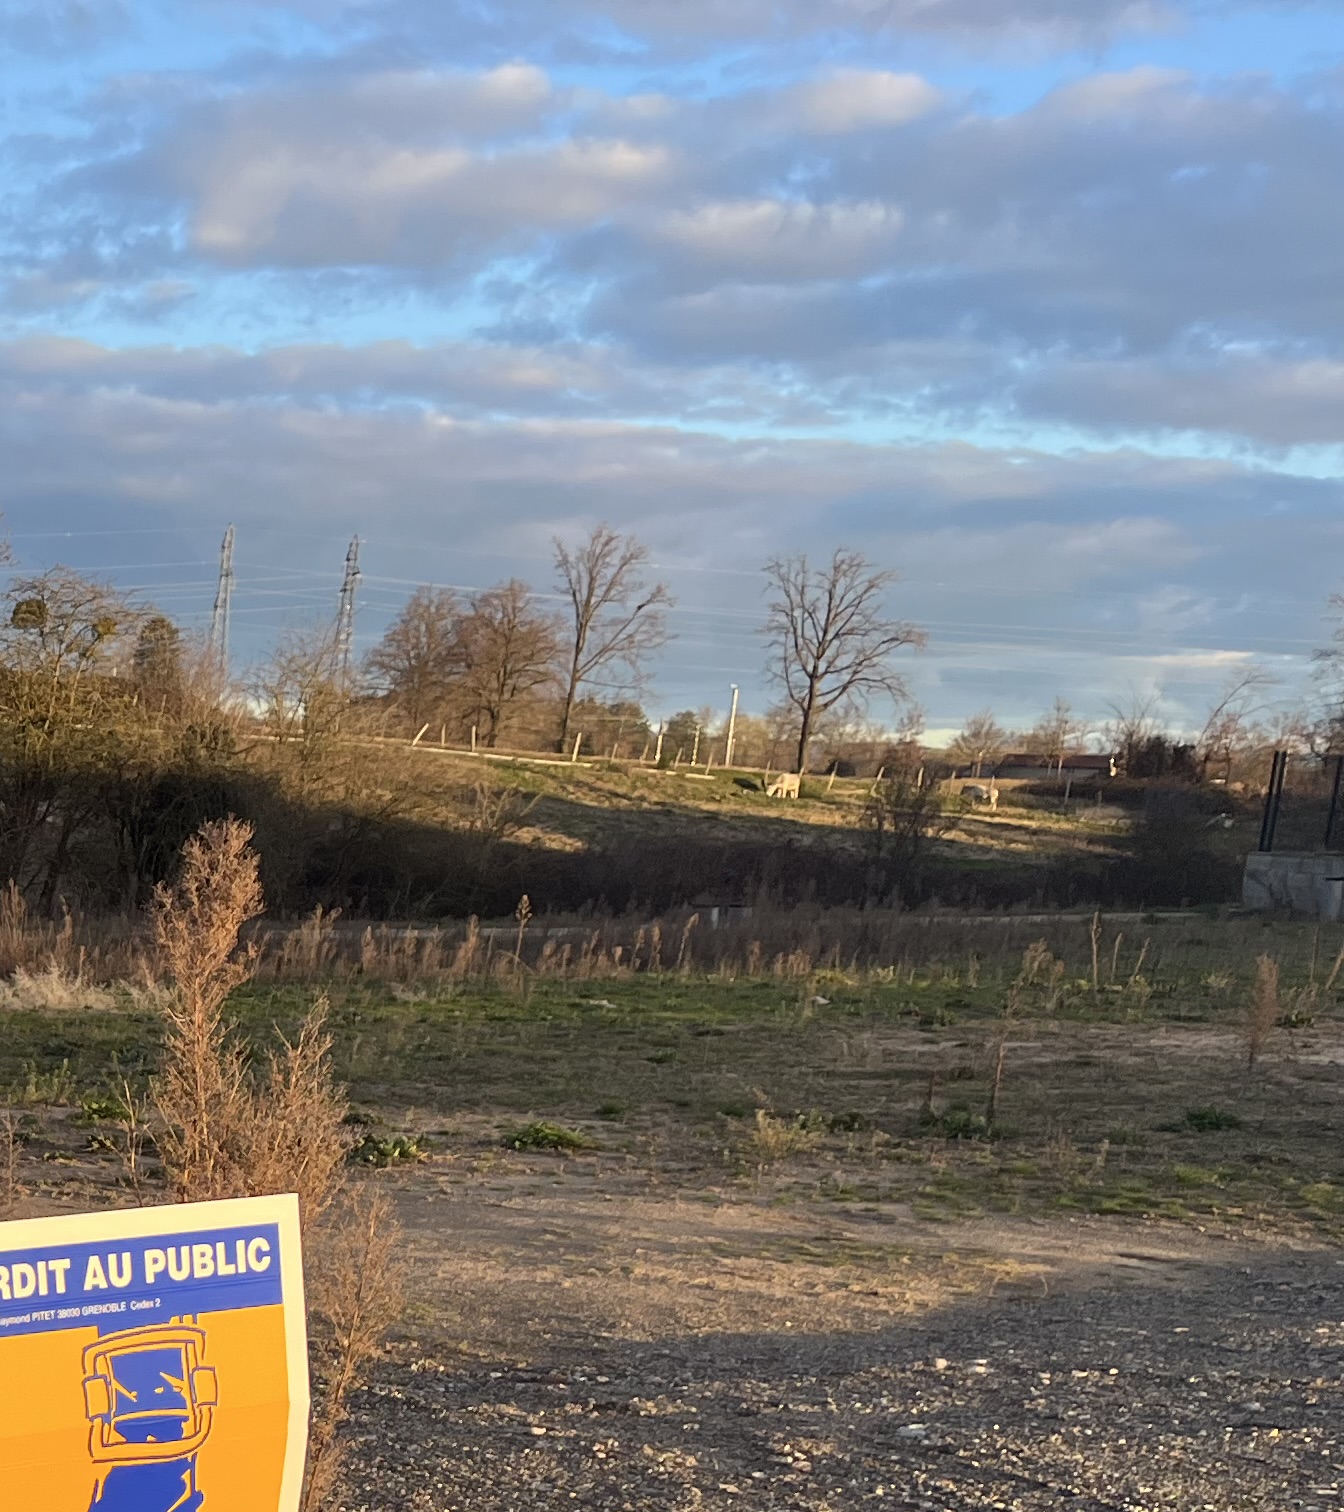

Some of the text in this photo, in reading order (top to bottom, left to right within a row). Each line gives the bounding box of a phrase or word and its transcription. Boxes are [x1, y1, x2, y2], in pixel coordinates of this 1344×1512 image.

[83, 1250, 132, 1291] AU
[144, 1237, 272, 1285] PUBLIC
[32, 1309, 55, 1322] PITET
[82, 1301, 127, 1316] GRENOBLE
